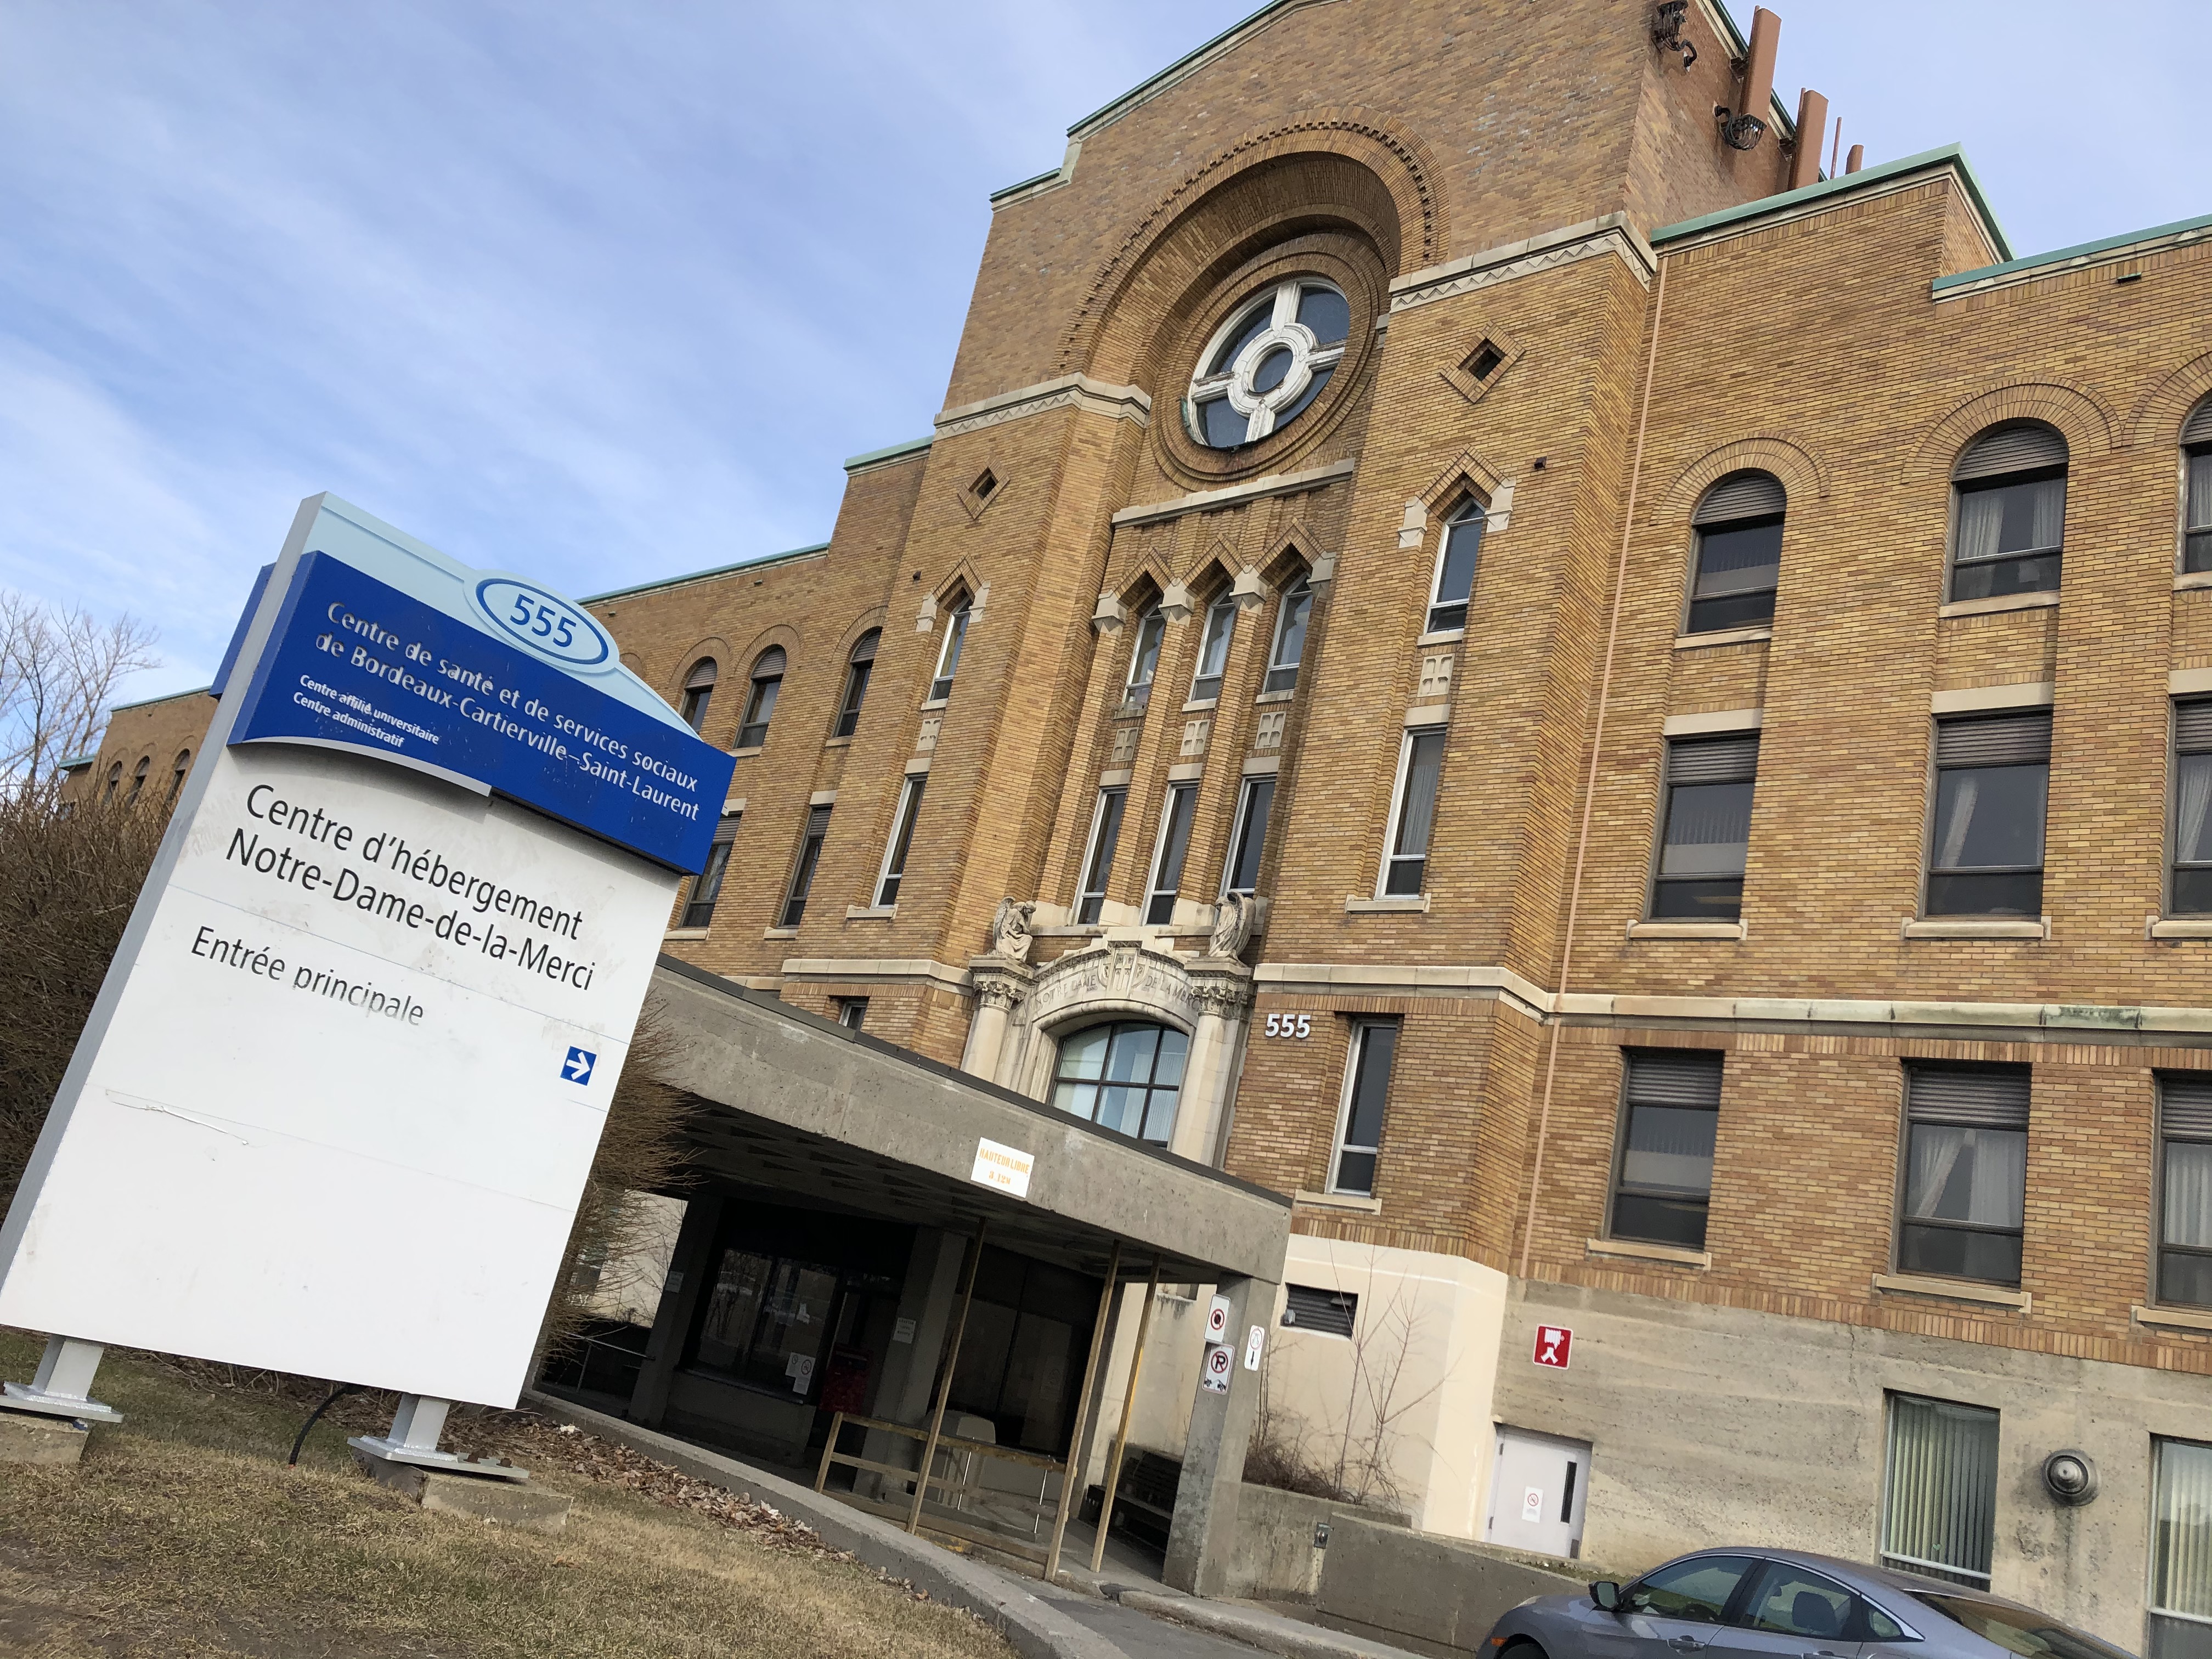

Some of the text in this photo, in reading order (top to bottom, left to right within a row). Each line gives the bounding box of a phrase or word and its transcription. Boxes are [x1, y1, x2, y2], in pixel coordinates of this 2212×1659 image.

[315, 632, 345, 657] de
[510, 594, 577, 647] 555
[294, 692, 405, 747] Centre administratif
[300, 675, 439, 744] Centre affilié universitaire
[328, 602, 698, 792] Centre de santé et de services sociaux
[247, 785, 353, 850] Centre
[225, 827, 596, 991] Notre-Dame-de-la-Merci
[191, 926, 424, 1026] Entrée principale
[1172, 985, 1201, 1011] MERC
[1265, 1013, 1311, 1039] 555
[979, 1148, 1030, 1174] HAUTEUR LIBRE
